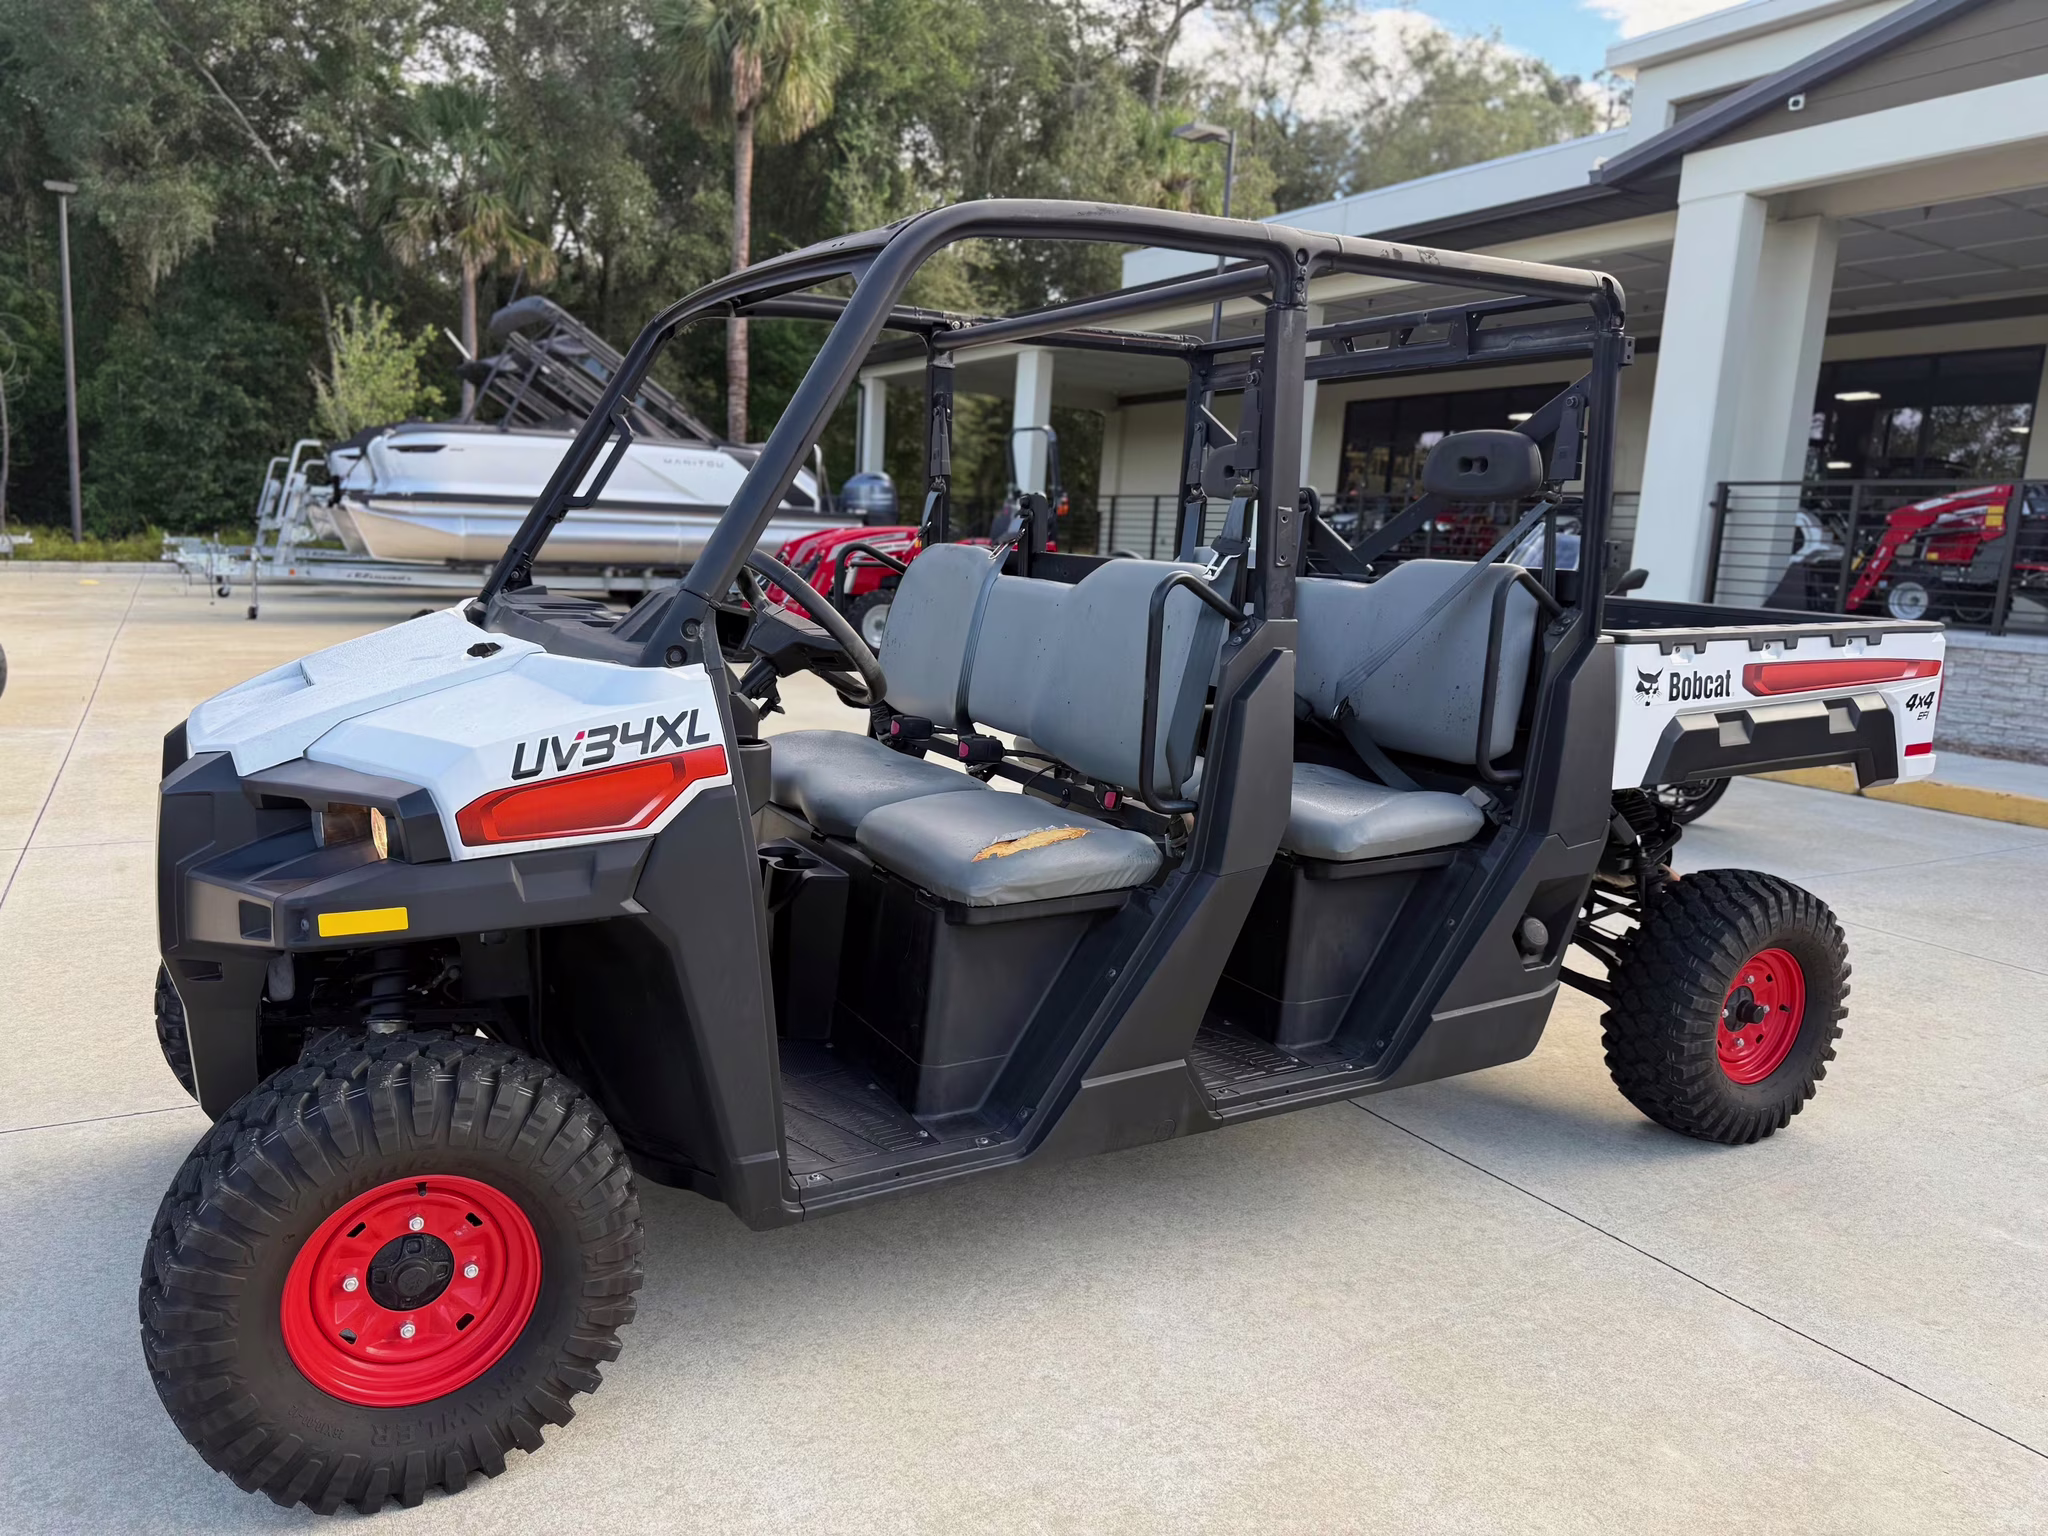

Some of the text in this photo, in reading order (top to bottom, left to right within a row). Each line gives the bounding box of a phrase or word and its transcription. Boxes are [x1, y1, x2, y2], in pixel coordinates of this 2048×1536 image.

[1668, 669, 1732, 702] Bobcat
[1905, 691, 1935, 711] 4x4
[511, 708, 710, 780] UV34XL
